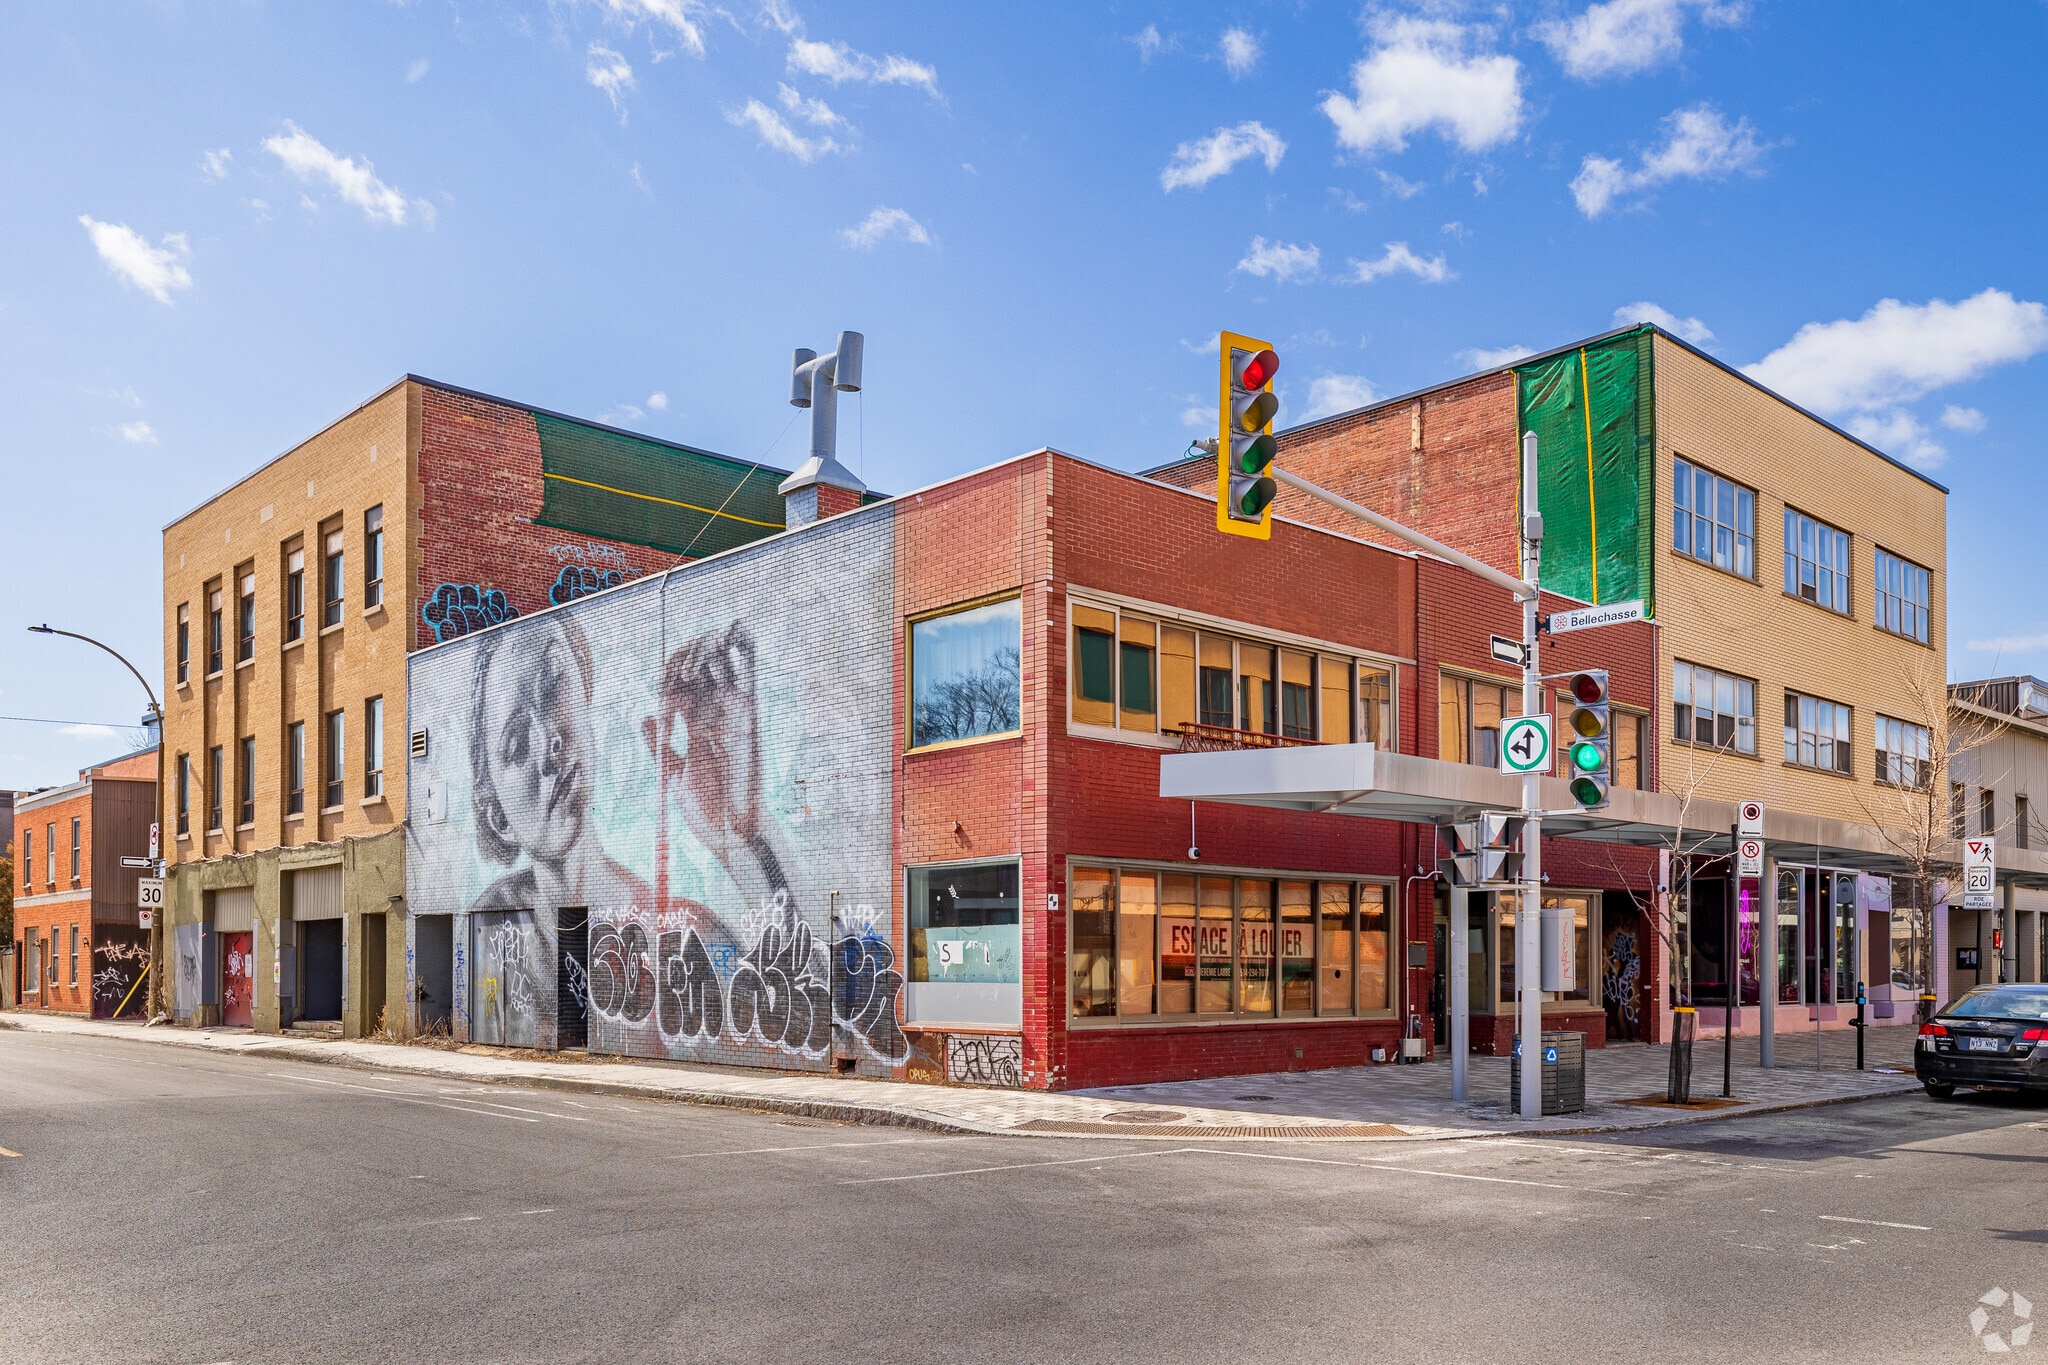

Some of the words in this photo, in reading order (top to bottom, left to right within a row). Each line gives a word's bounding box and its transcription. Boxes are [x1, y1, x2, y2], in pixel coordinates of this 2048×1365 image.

[1571, 609, 1637, 627] Bellechasse
[1971, 875, 1987, 887] 20
[141, 887, 161, 903] 30
[1172, 925, 1228, 955] ESPACE
[1239, 923, 1249, 955] À
[1252, 928, 1302, 956] LOUER
